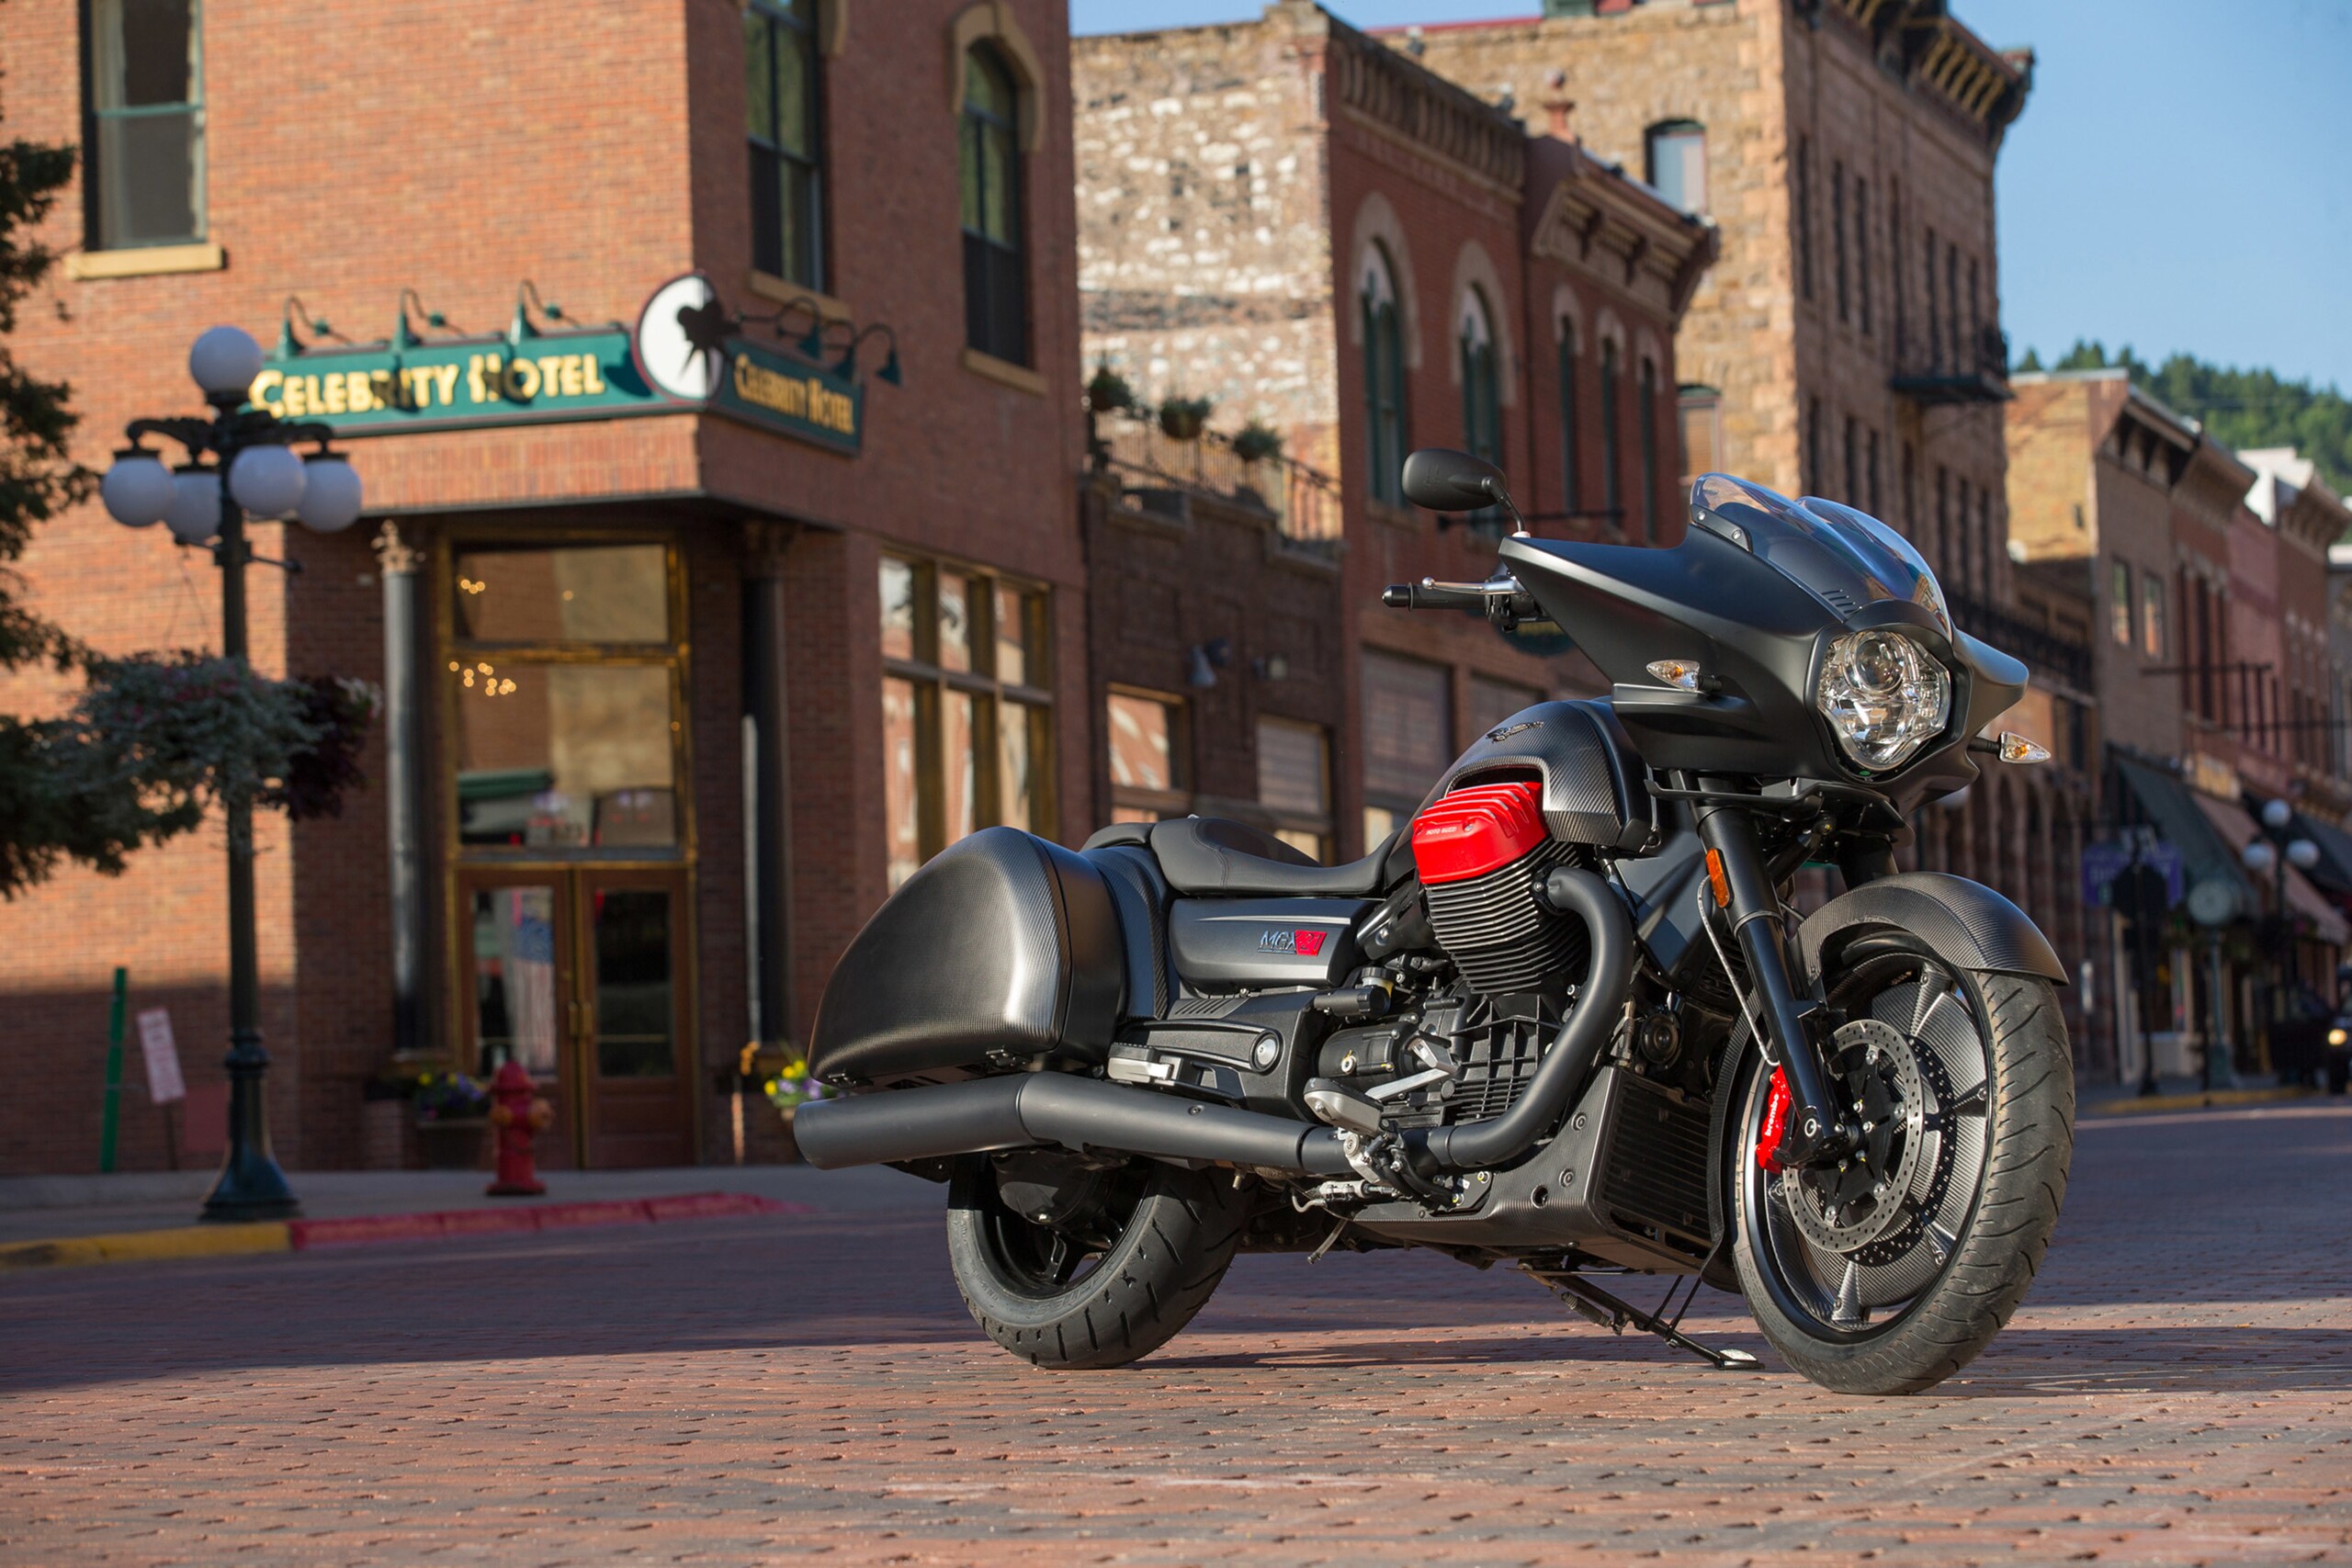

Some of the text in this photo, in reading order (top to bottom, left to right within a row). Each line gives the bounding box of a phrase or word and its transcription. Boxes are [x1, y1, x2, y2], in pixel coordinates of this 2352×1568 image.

[248, 353, 605, 419] CELEBRITY HOTEL
[1765, 1094, 1779, 1136] brembo
